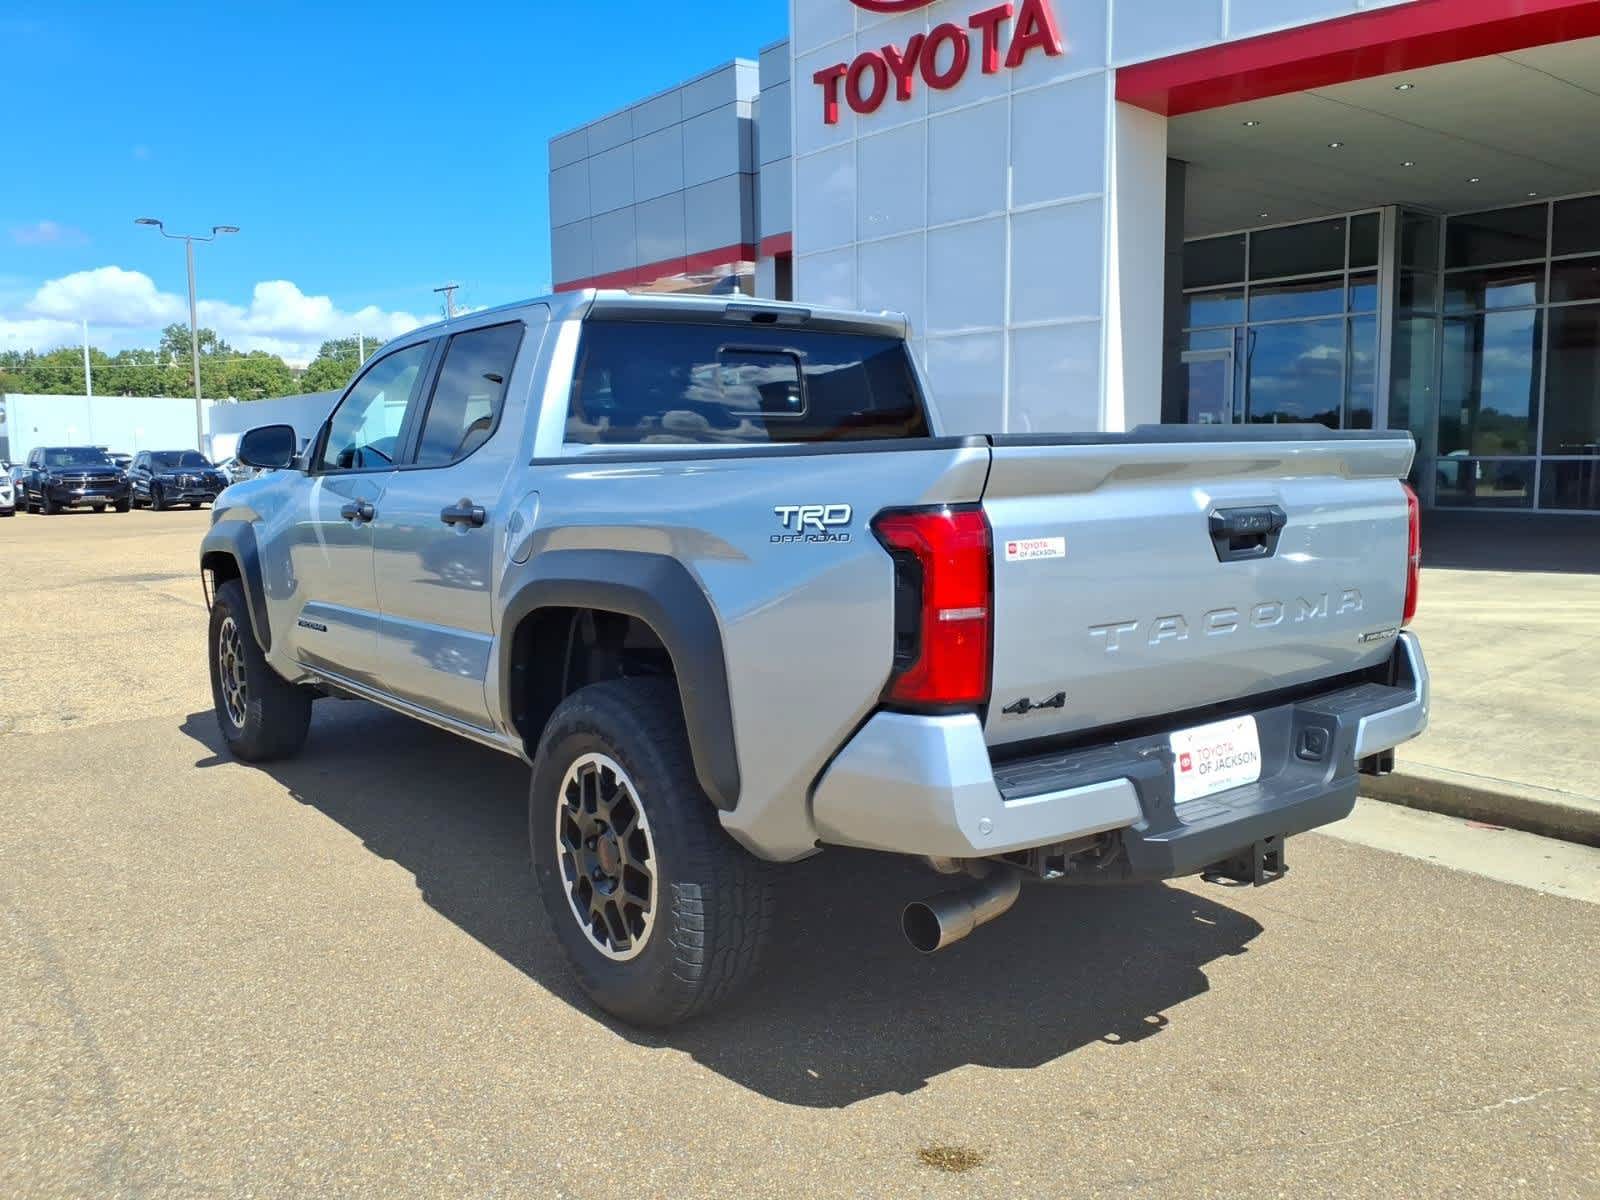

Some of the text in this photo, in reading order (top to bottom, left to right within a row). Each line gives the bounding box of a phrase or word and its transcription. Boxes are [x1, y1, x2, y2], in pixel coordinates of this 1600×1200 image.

[813, 0, 1063, 125] TOYOTA
[774, 503, 852, 533] TRD
[770, 533, 851, 544] OFF ROAD
[1020, 541, 1048, 550] TOYOTA
[1030, 549, 1057, 557] JACKSON
[1088, 589, 1364, 651] TACOMA
[1197, 743, 1234, 761] TOYOTA
[1199, 751, 1257, 775] OF JACKSON
